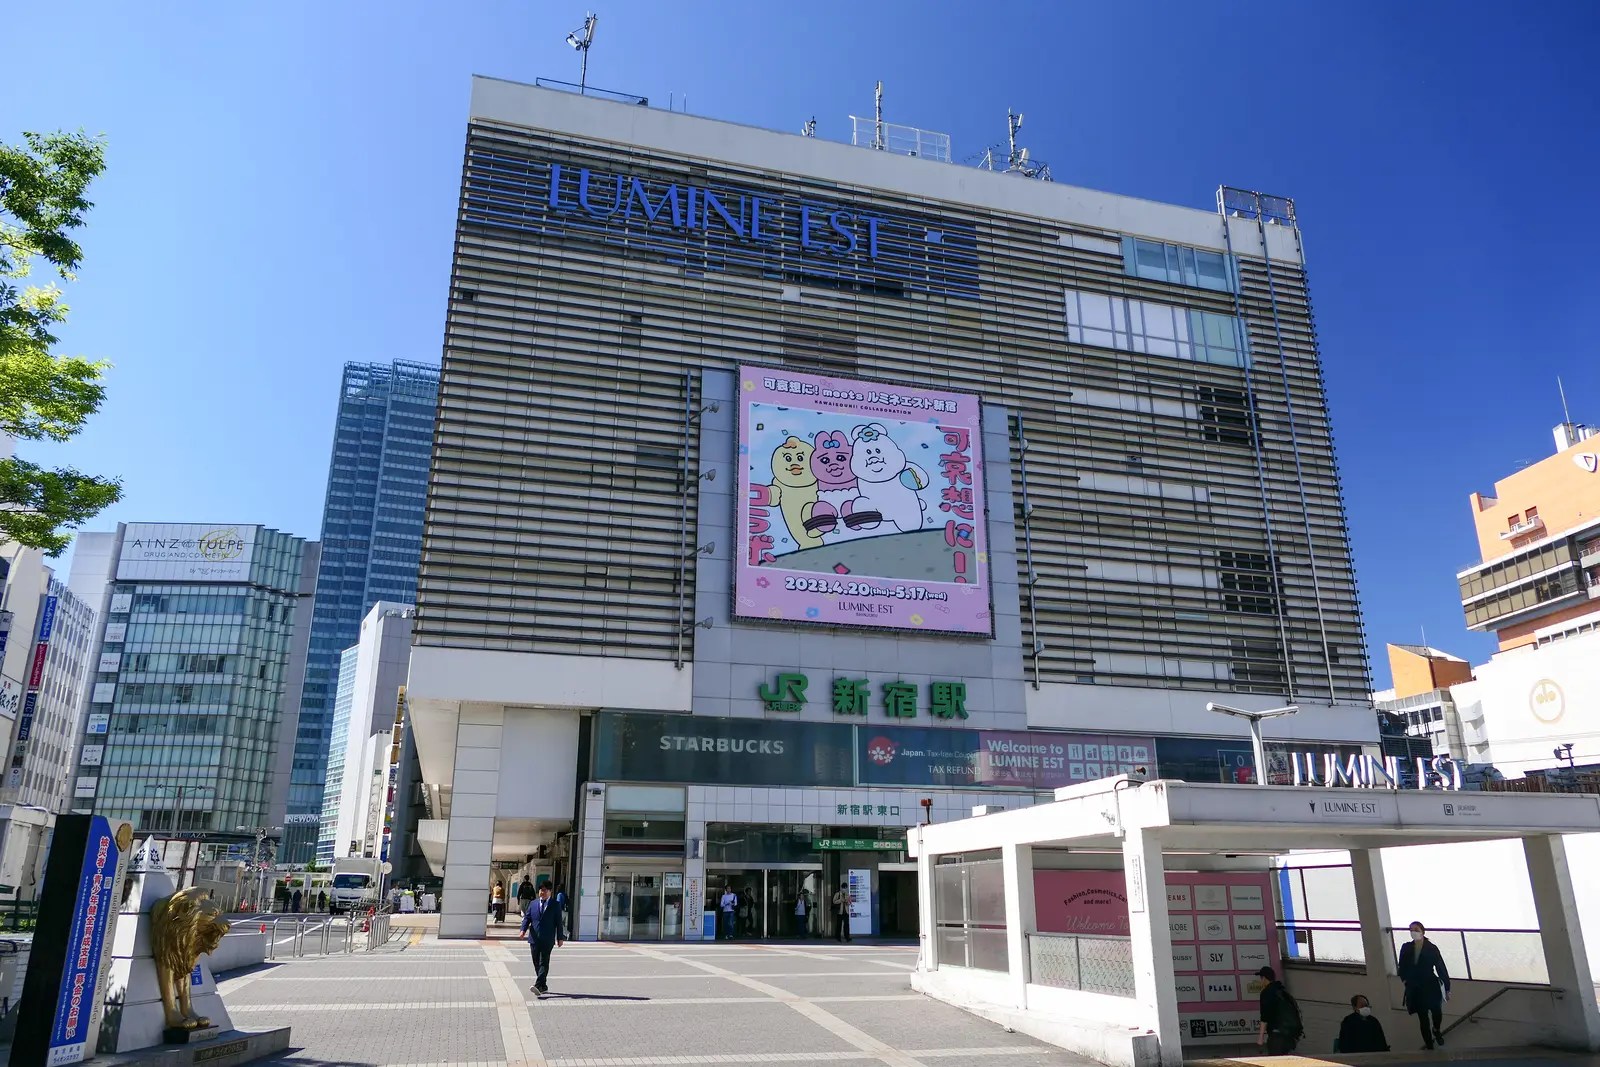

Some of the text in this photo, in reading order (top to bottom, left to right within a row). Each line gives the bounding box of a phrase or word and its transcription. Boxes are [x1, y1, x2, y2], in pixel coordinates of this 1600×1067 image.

[549, 163, 896, 260] LUMINE EST
[822, 388, 865, 401] meets
[867, 391, 958, 414] ルミネエスト新宿
[860, 405, 912, 415] COLLABORATION
[132, 538, 244, 551] AINZ TULPE
[169, 551, 187, 559] AND
[838, 601, 894, 614] LUMINE EST
[760, 672, 809, 703] JR
[833, 676, 970, 720] 新宿駅
[658, 734, 785, 756] STARBUCKS
[987, 739, 1064, 755] Welcome to
[901, 748, 926, 758] Japan.
[988, 754, 1065, 769] LUMINE EST
[928, 765, 945, 774] TAX
[946, 766, 981, 775] REFUND
[1291, 752, 1406, 790] LUMINE
[1416, 754, 1465, 791] EST
[1324, 801, 1376, 814] LUMINE EST
[1066, 915, 1116, 931] Welcome
[1210, 953, 1224, 963] SLY
